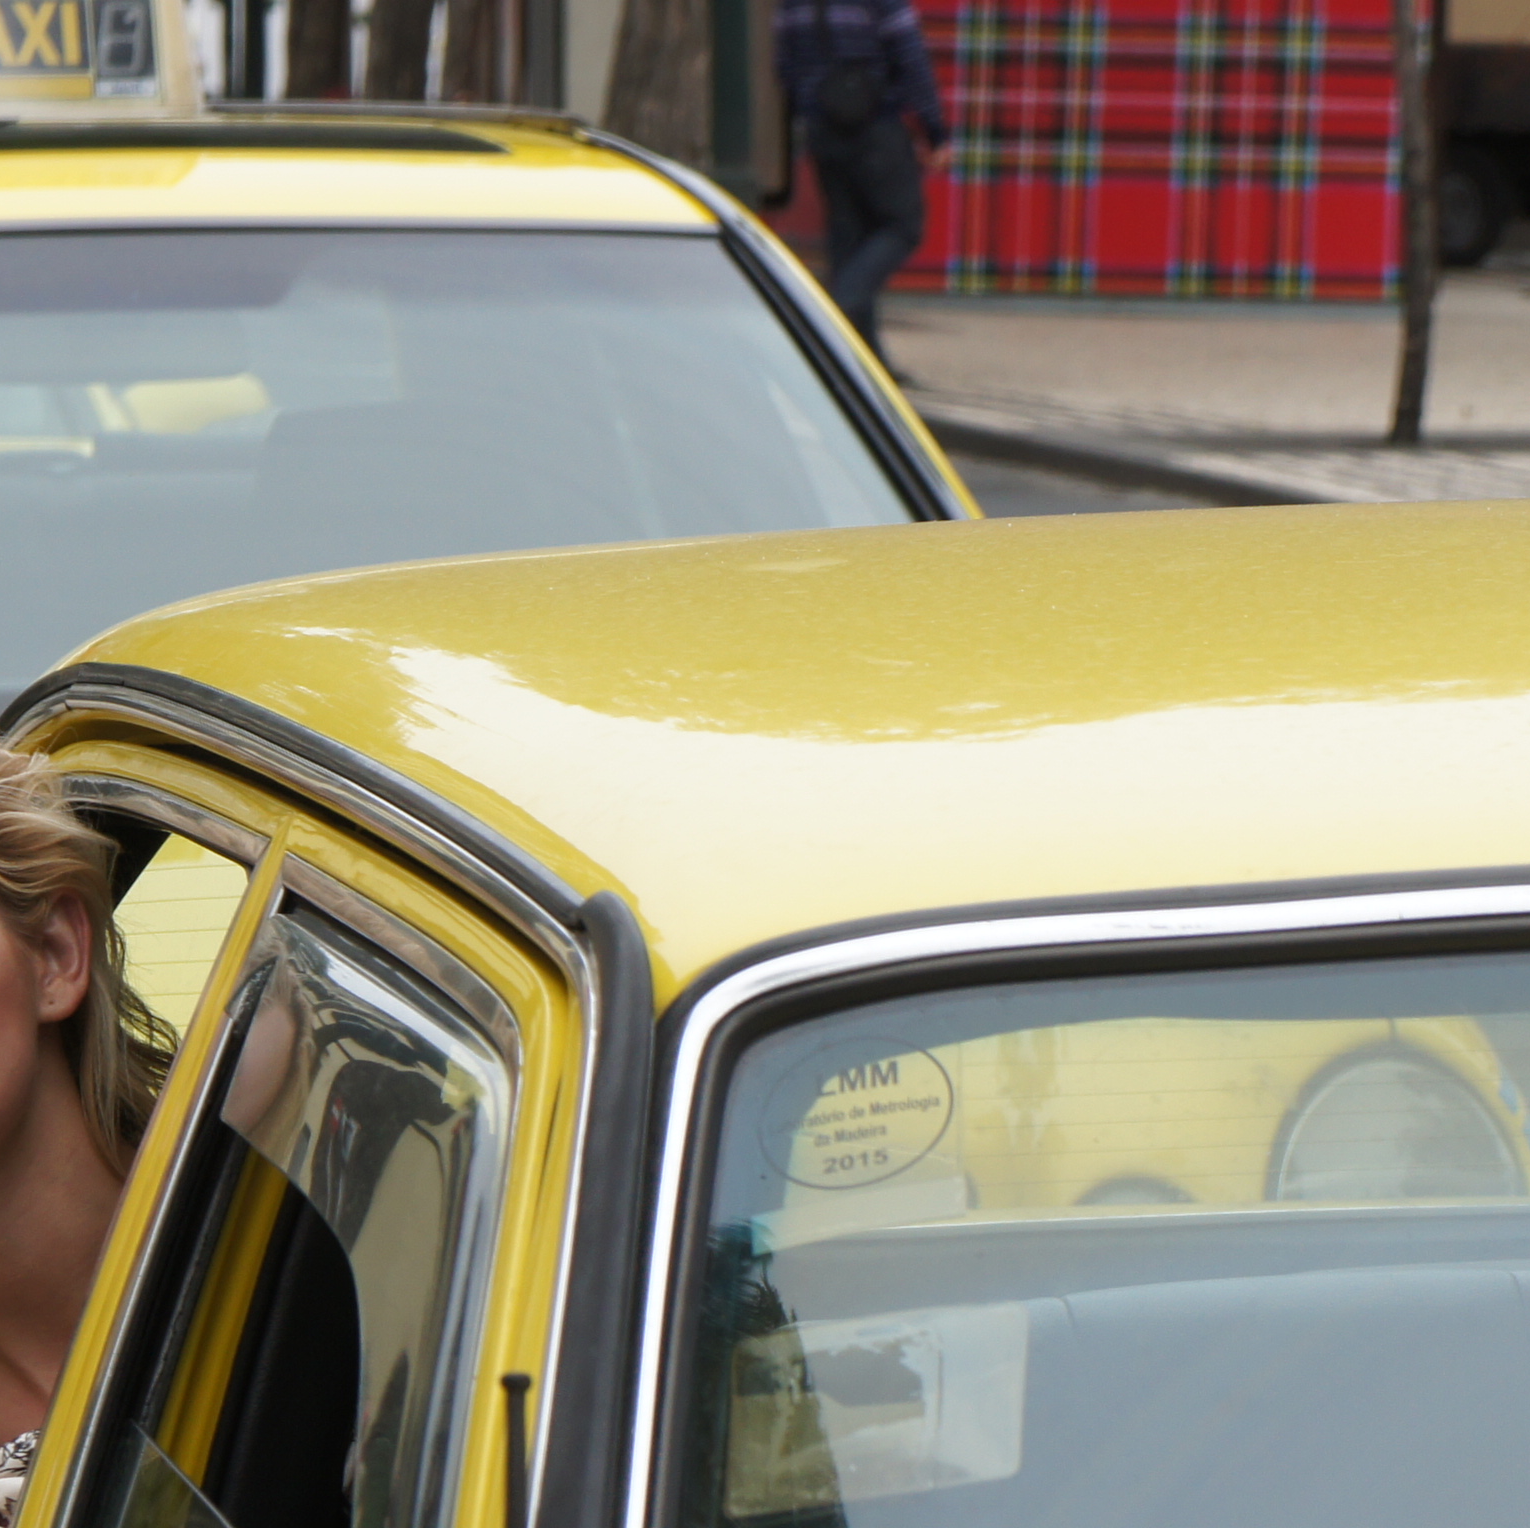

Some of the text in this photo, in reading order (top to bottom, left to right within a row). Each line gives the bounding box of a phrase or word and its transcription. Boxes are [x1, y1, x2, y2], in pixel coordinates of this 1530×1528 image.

[815, 1061, 899, 1096] LMM
[848, 1105, 866, 1120] de
[870, 1095, 941, 1117] Metrologia
[833, 1123, 887, 1143] Madeira
[822, 1149, 889, 1174] 2015
